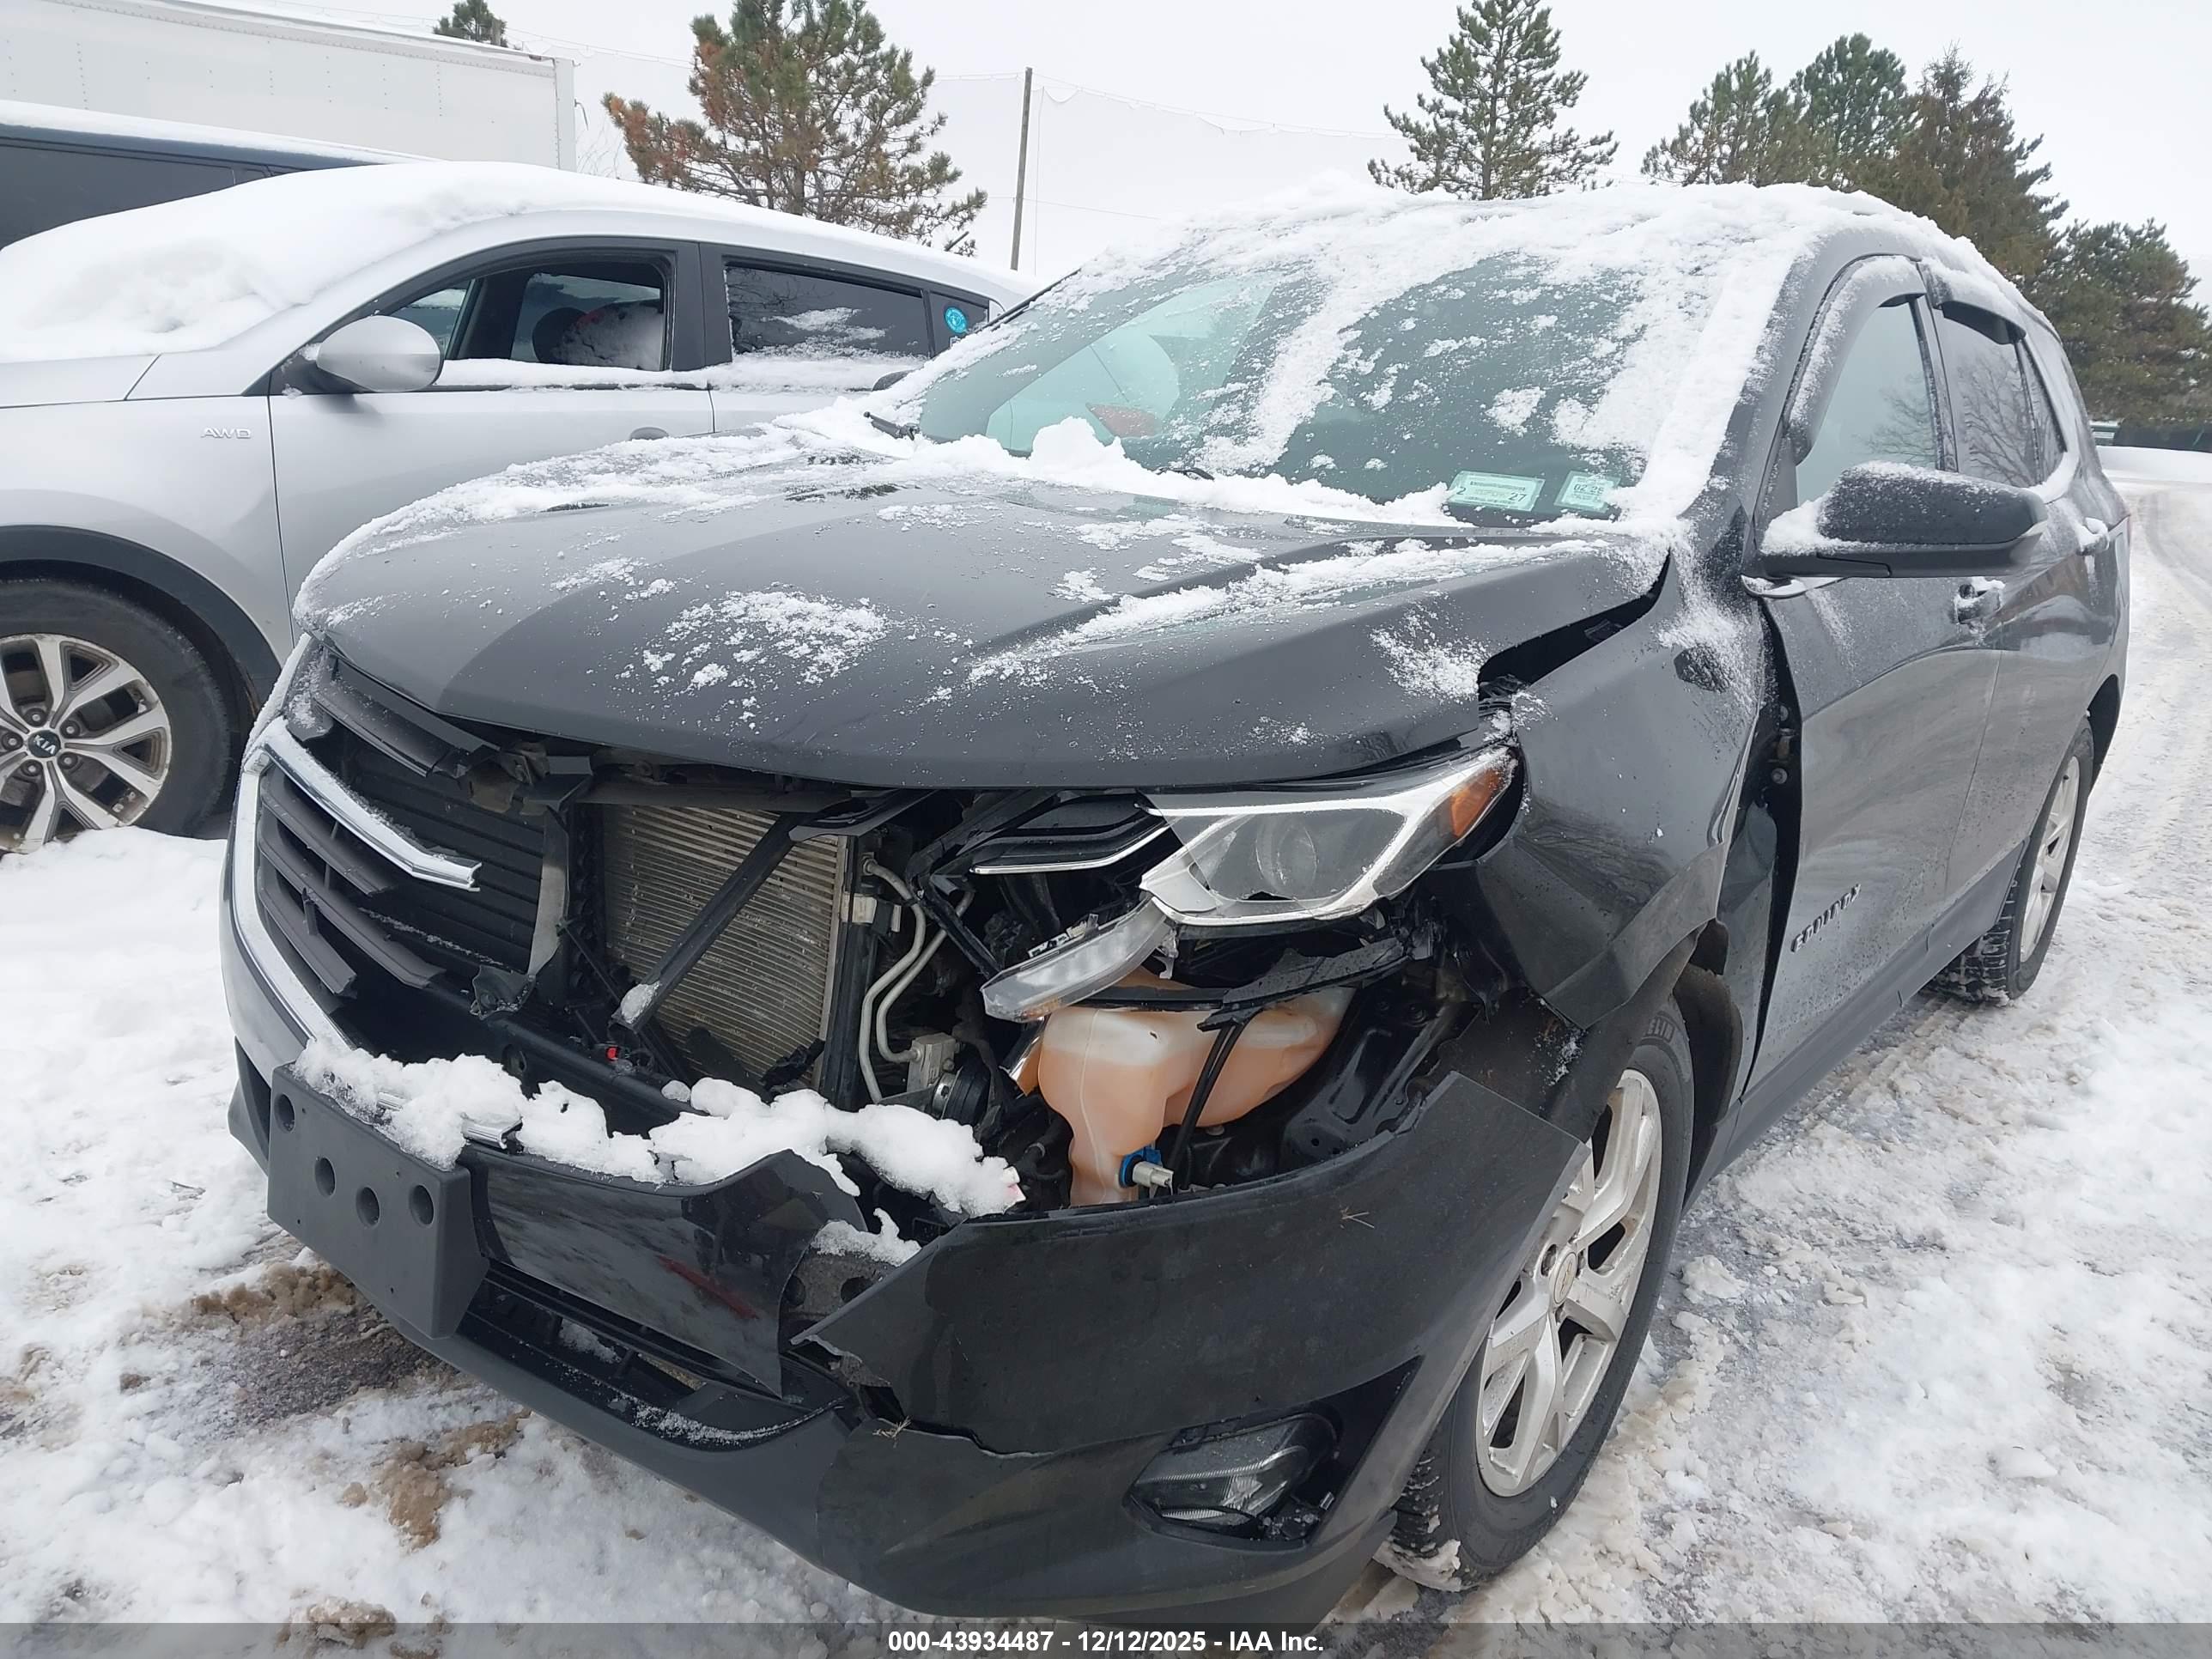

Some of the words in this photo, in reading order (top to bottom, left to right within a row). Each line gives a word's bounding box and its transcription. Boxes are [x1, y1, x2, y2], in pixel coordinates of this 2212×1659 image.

[200, 428, 252, 439] AWD
[1509, 492, 1527, 502] 27
[33, 734, 57, 755] KIA
[1790, 884, 1862, 953] EQUINOX
[1644, 1018, 1674, 1042] ELIN
